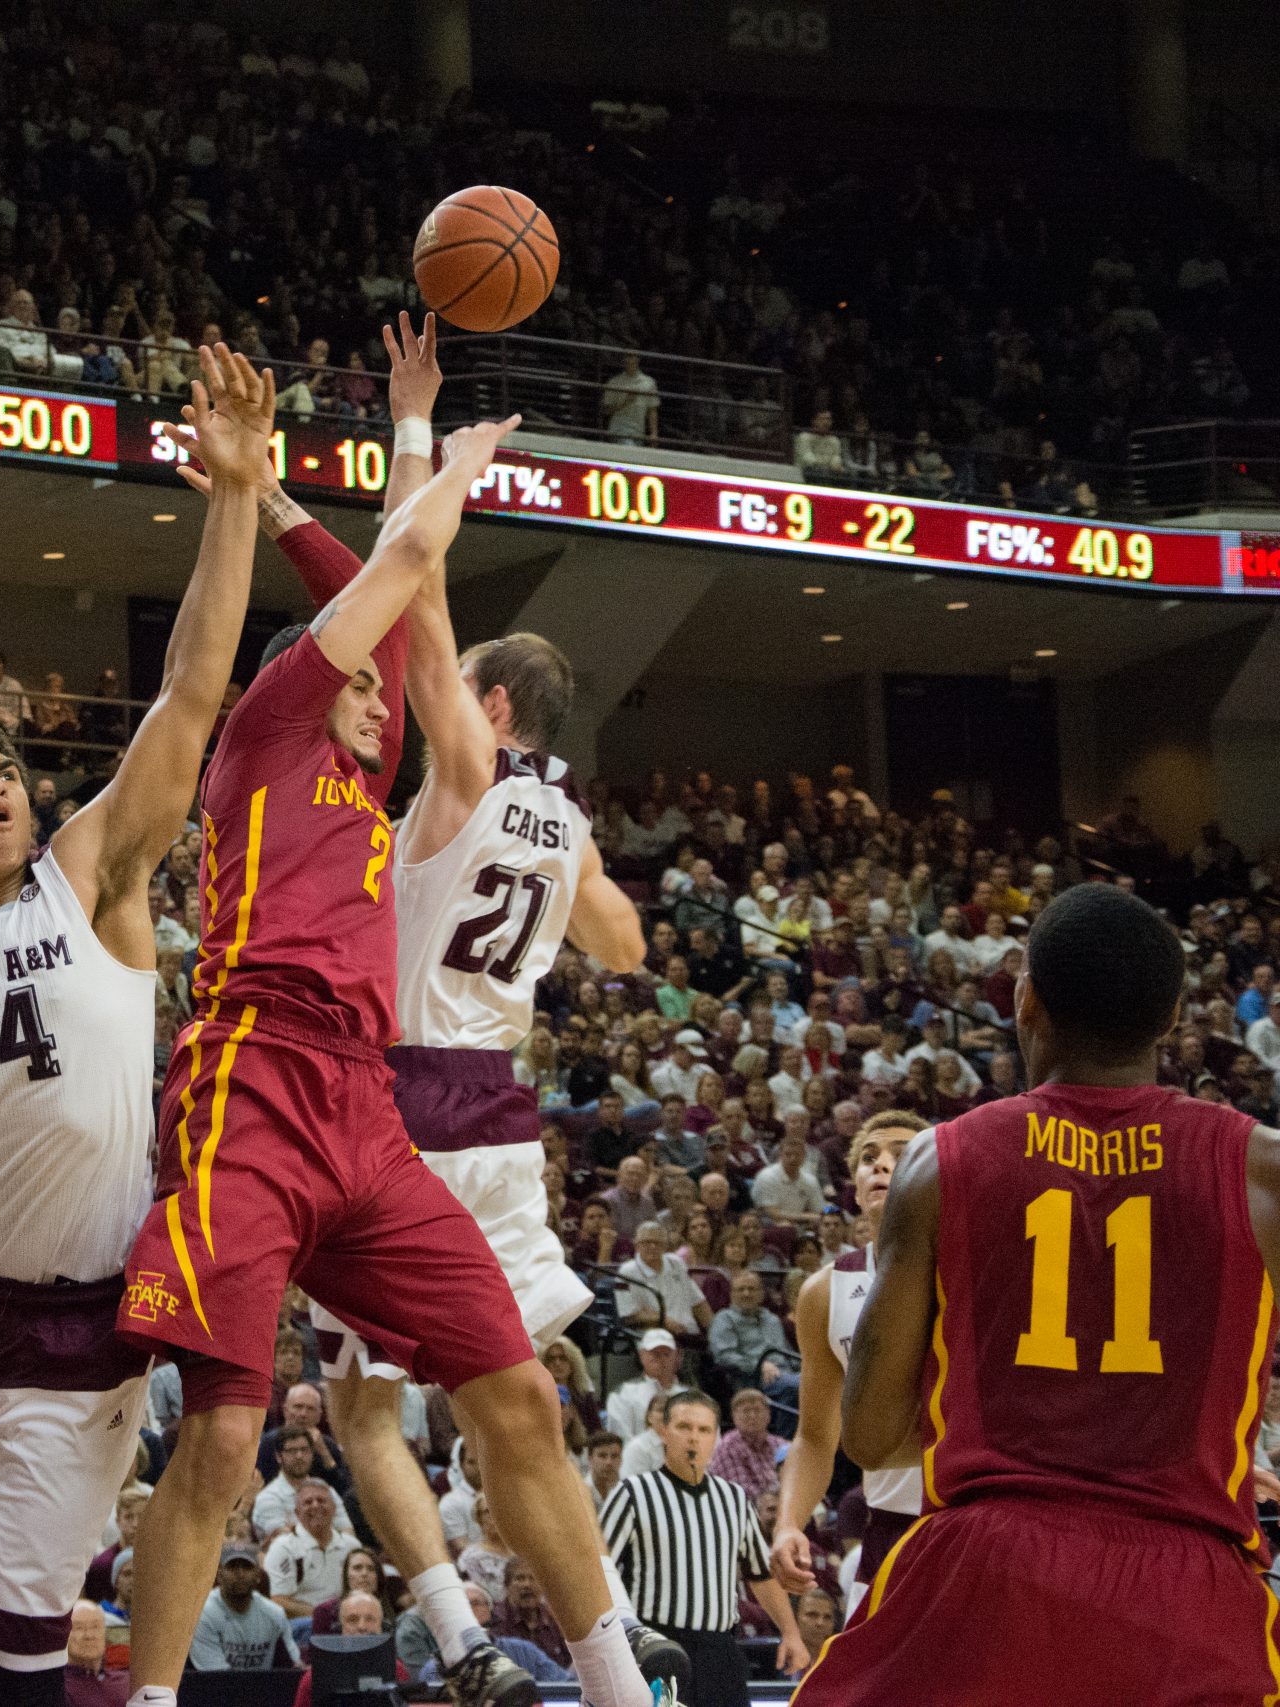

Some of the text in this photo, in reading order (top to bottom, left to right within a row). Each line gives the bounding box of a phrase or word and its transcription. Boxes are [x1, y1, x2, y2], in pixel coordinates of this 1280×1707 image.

[729, 9, 829, 50] 208
[336, 439, 387, 491] 10
[583, 469, 665, 524] 10.0
[718, 490, 779, 534] FG:
[784, 493, 814, 541] 9
[966, 520, 1154, 580] FG%: 40.9
[313, 776, 375, 813] IOWA
[363, 823, 391, 904] 2
[441, 862, 553, 984] 21
[4, 933, 74, 983] A&M
[1024, 1112, 1164, 1177] MORRIS
[1014, 1188, 1165, 1375] 11
